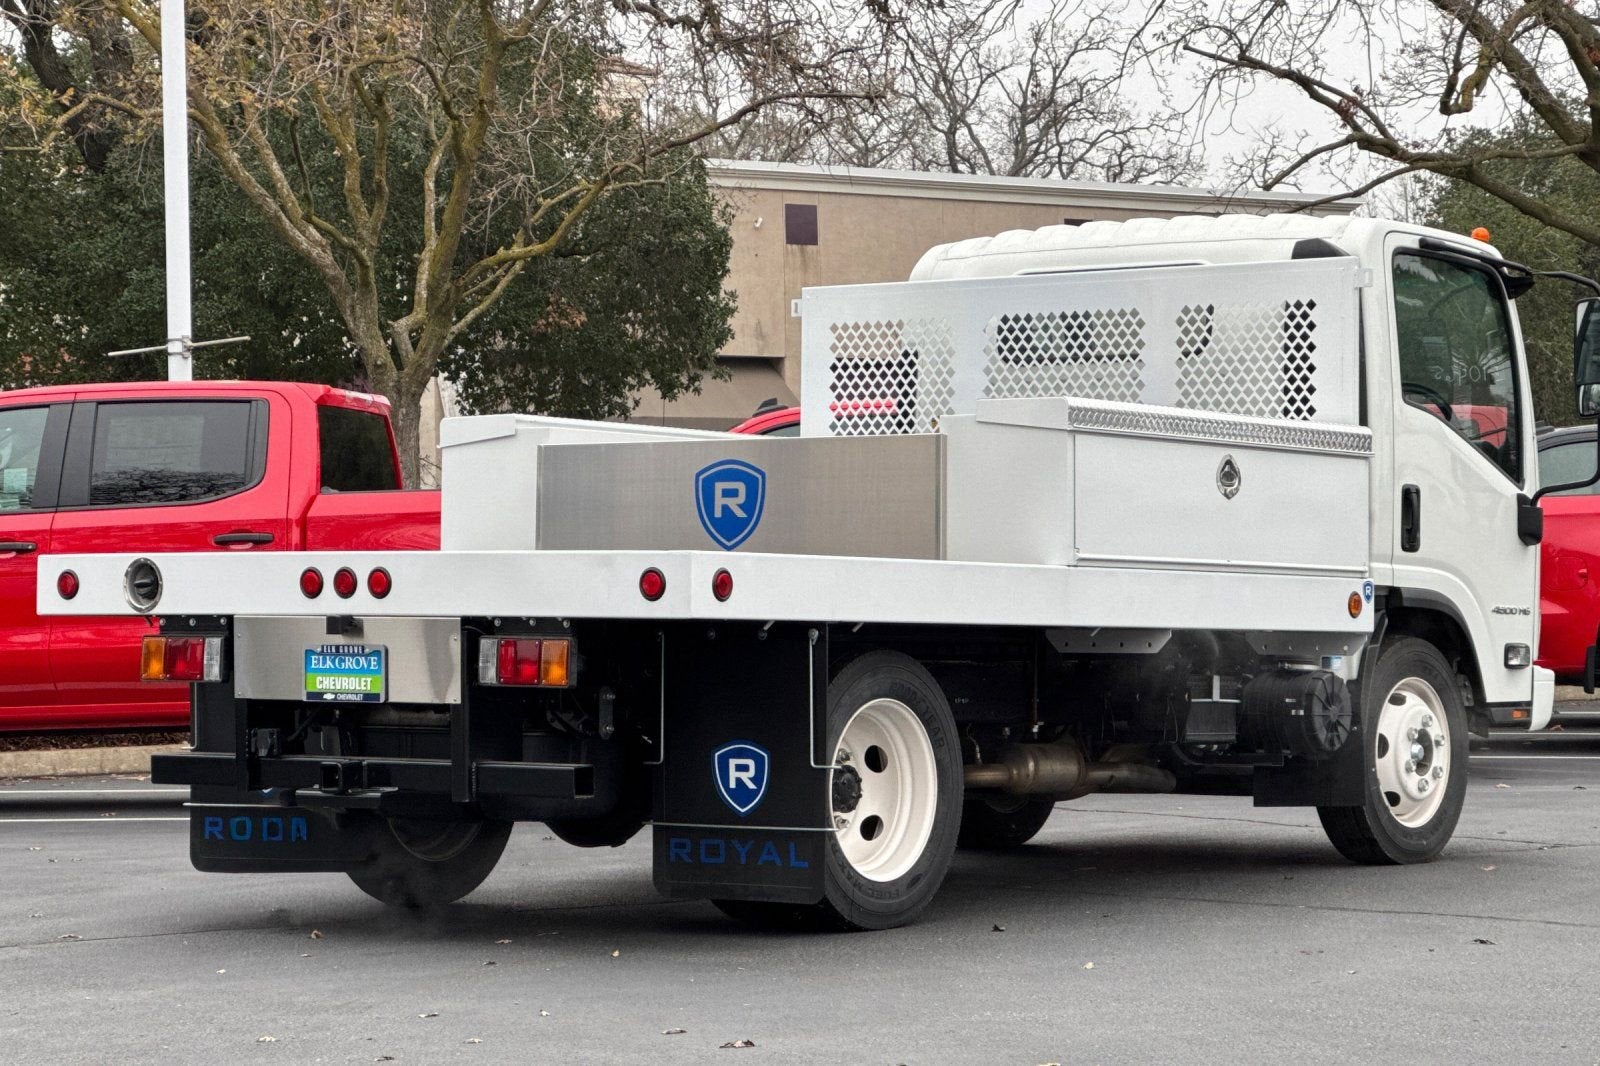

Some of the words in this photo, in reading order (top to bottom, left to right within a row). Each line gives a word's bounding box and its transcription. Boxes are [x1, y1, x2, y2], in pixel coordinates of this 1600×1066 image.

[714, 481, 748, 518] R
[1364, 586, 1373, 597] R
[310, 655, 335, 669] ELK
[335, 656, 379, 670] GROVE
[316, 676, 372, 691] CHEVROLET
[336, 693, 363, 701] CHEVROLET
[728, 758, 758, 790] R
[669, 837, 809, 868] ROYAL
